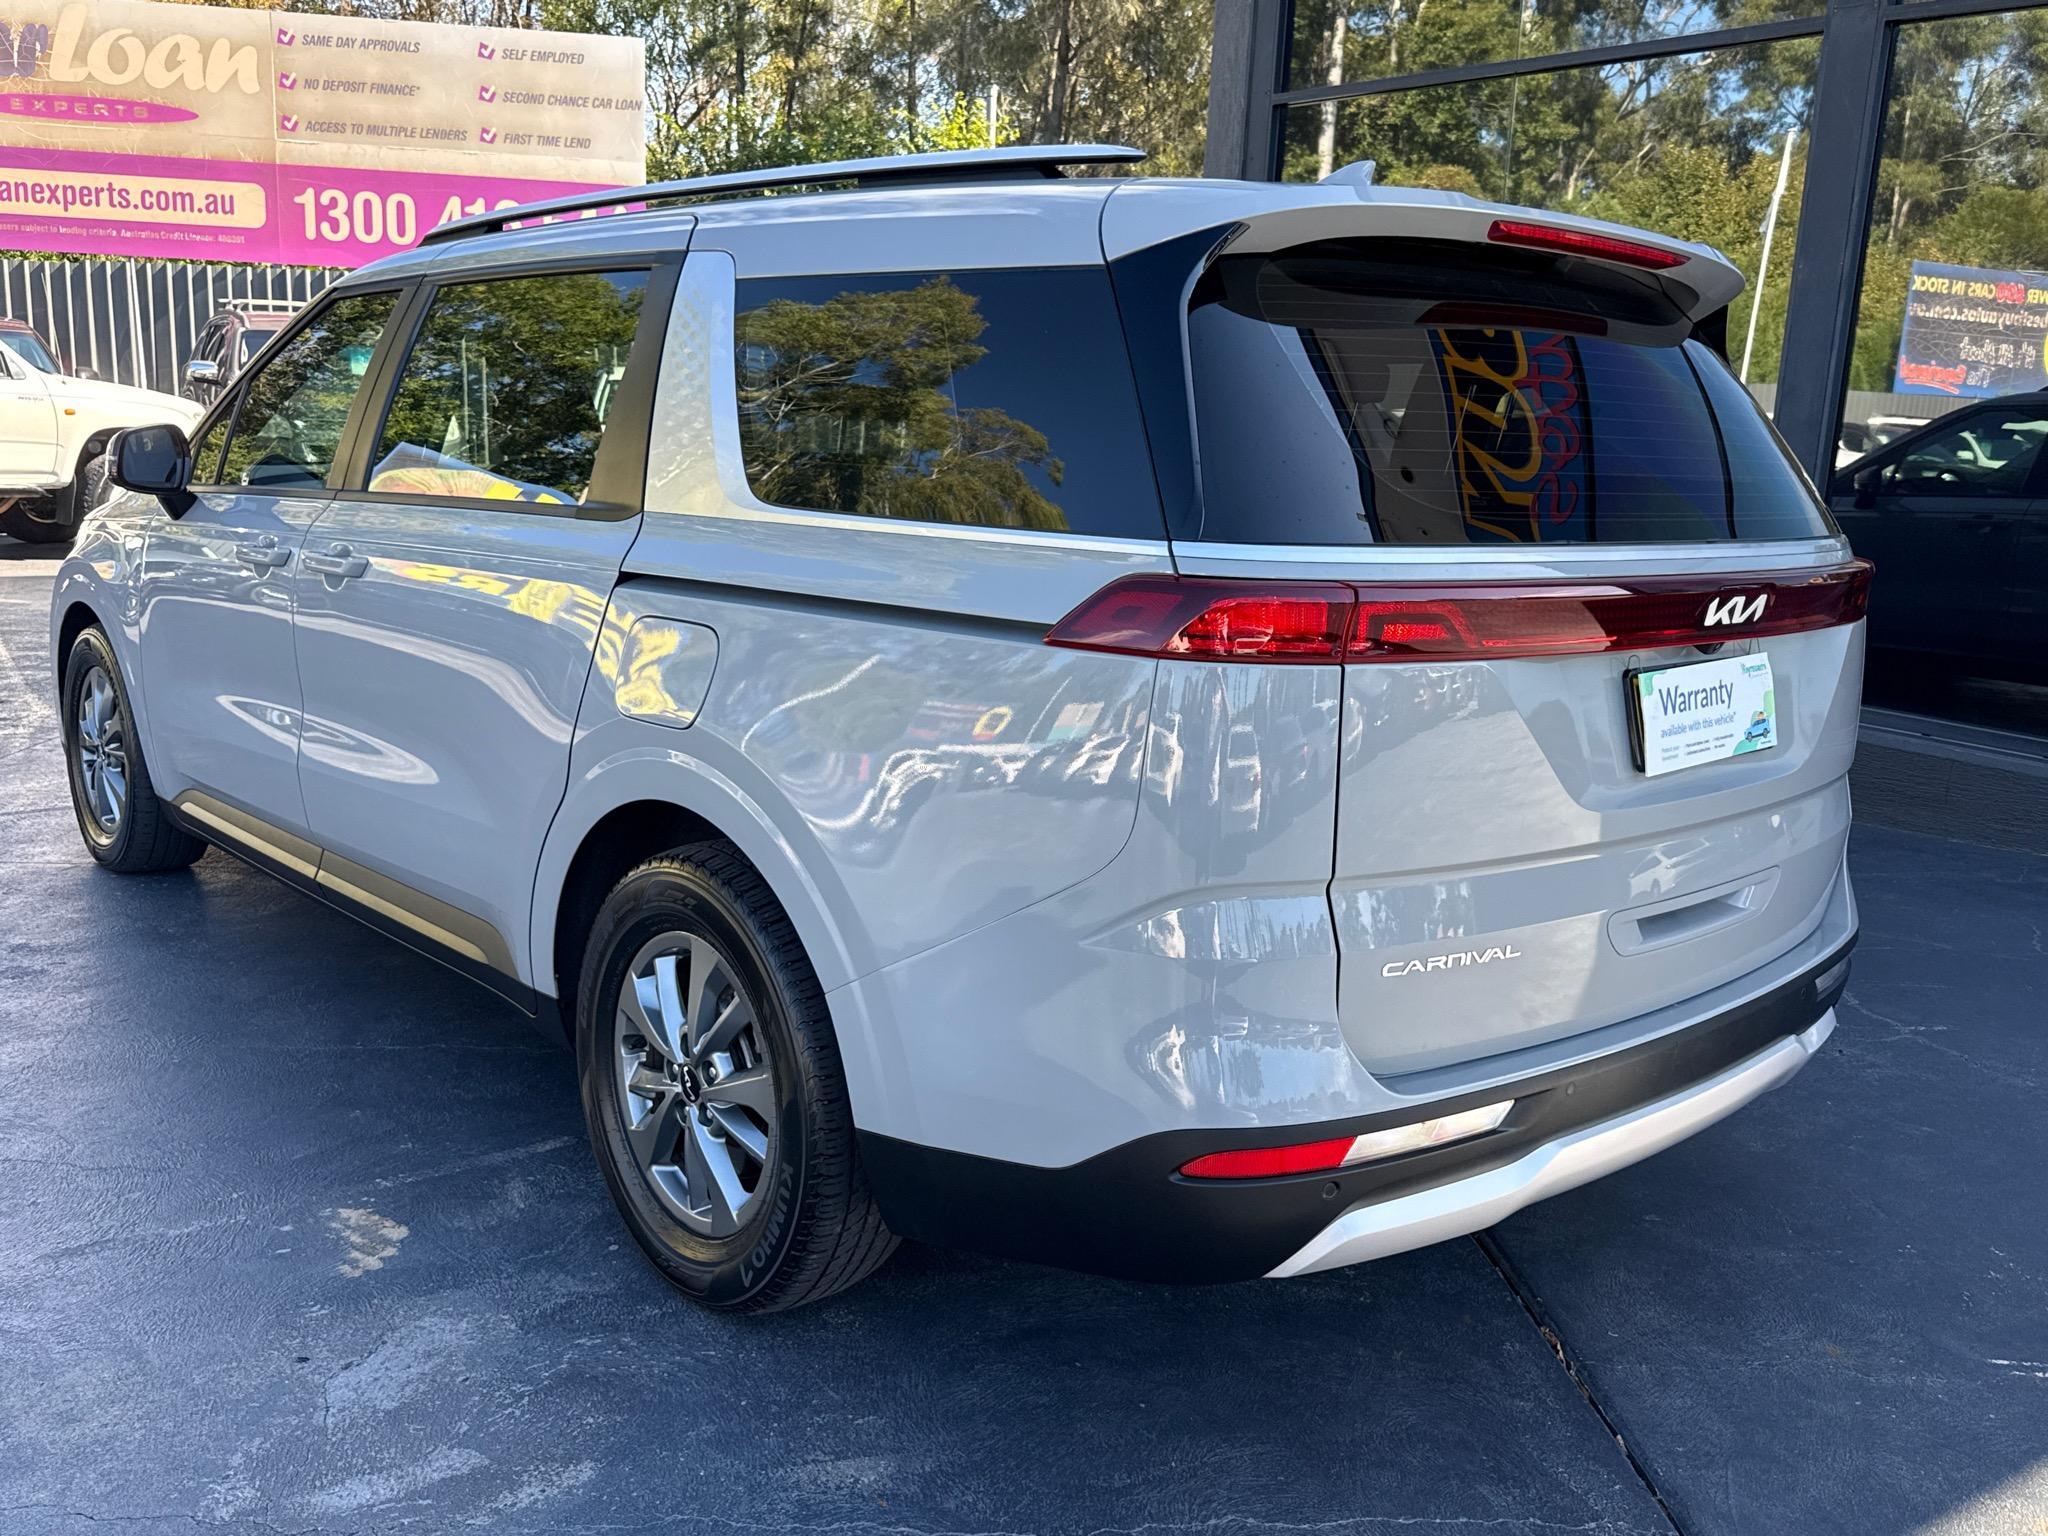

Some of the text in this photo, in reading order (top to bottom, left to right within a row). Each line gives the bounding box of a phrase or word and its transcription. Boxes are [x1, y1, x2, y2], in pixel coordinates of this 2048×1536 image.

[49, 3, 260, 94] Loan
[302, 34, 420, 53] SAME DAY APPROVALS
[501, 48, 584, 65] SELF EMPLOYED
[304, 78, 319, 90] NO
[322, 79, 367, 94] DEPOSIT
[10, 97, 149, 118] EXPERTS
[502, 91, 642, 111] SECOND CHANCE CAR LOAN
[305, 120, 468, 141] ACCESS TO MULTIPLE LENDERS
[503, 132, 591, 149] FIRST TIME LEND
[0, 180, 235, 216] anexperts.com.au
[293, 186, 416, 246] 1300
[1658, 679, 1734, 716] Warranty
[1382, 944, 1522, 978] CARNIVAL
